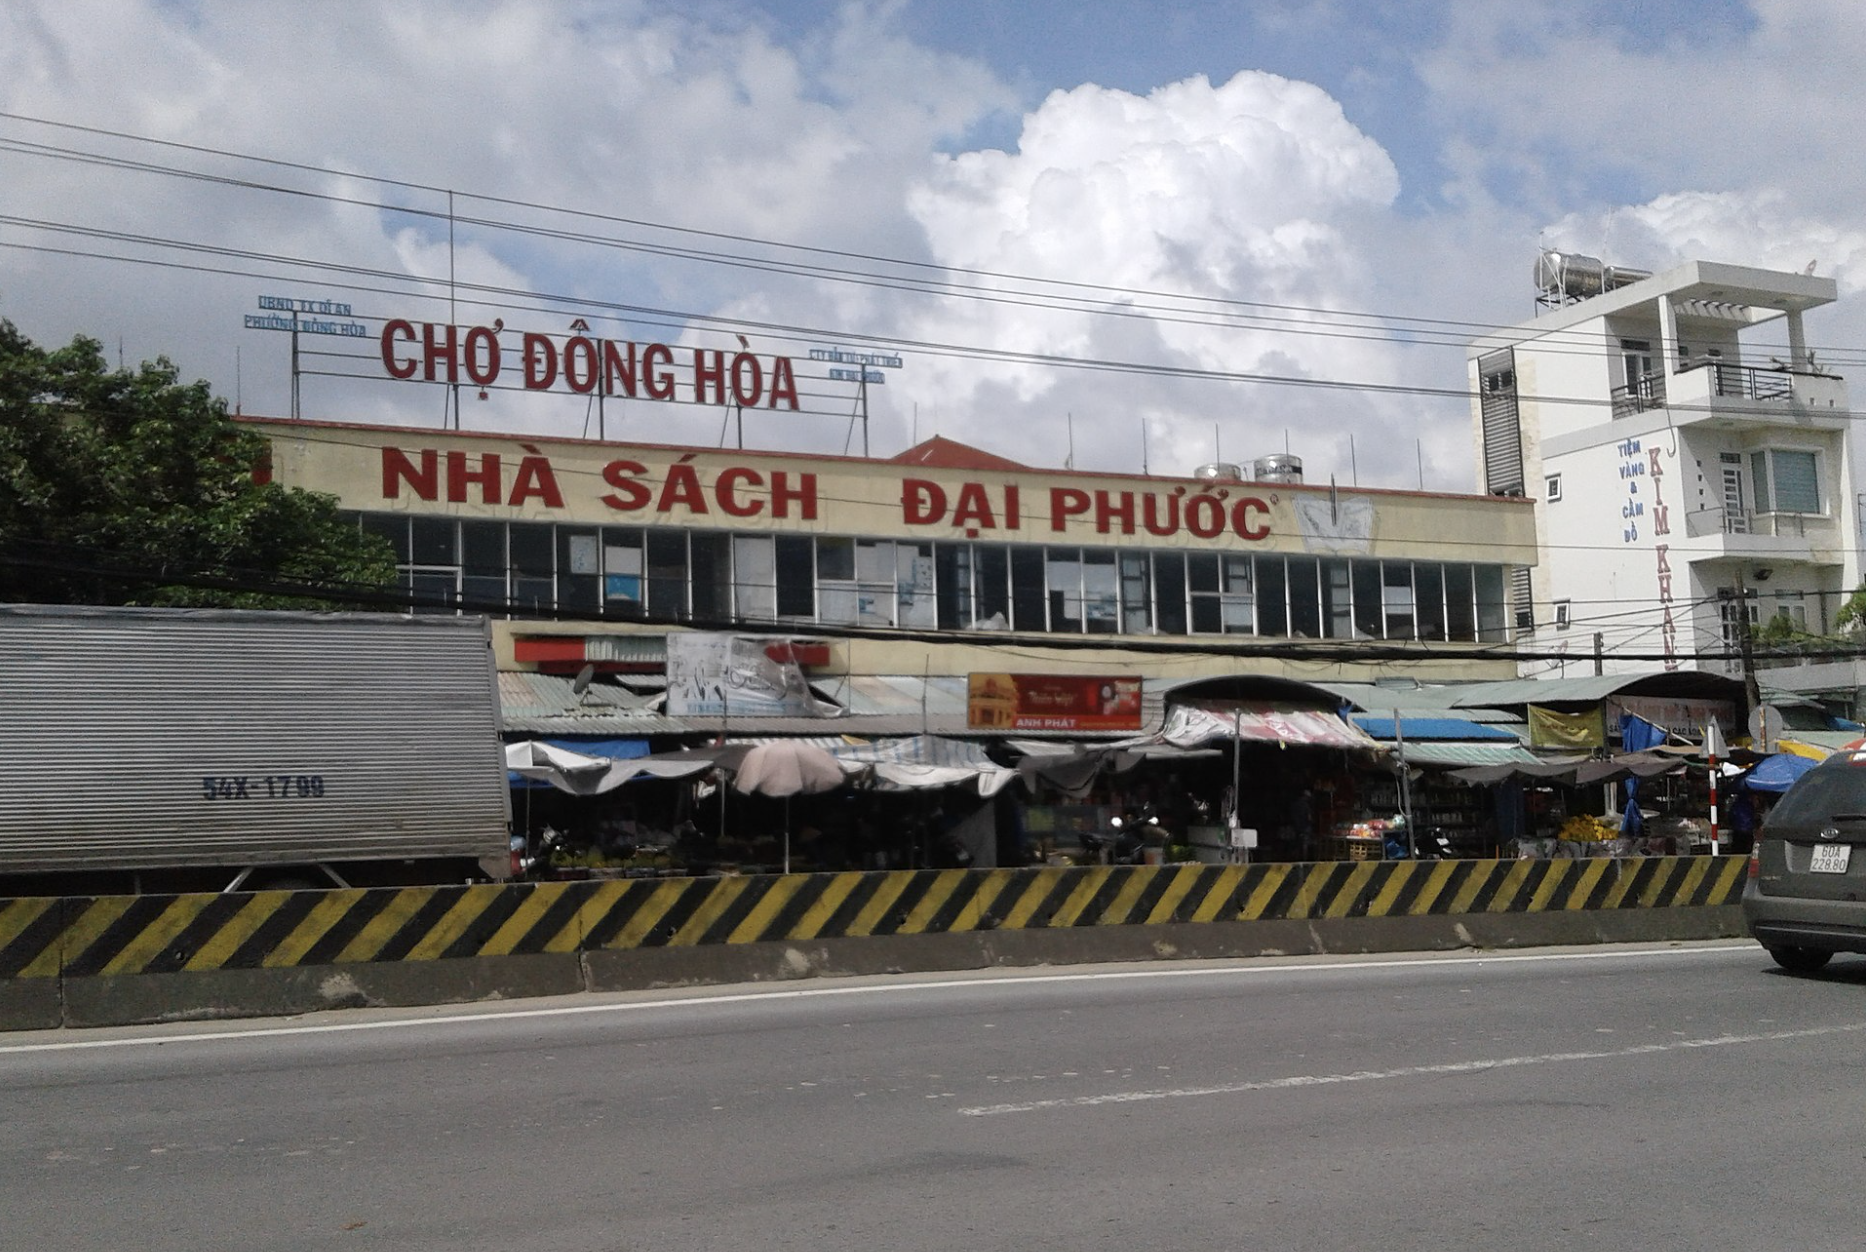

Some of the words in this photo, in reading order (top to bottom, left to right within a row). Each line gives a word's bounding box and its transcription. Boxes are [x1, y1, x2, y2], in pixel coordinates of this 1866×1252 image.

[381, 318, 504, 400] CHỢ
[522, 318, 676, 401] ĐÔNG
[694, 334, 799, 411] HÒA
[1617, 438, 1642, 459] TIỆM
[1619, 461, 1645, 480] VÀNG
[381, 443, 565, 509] NHÀ
[601, 453, 819, 521] SÁCH
[900, 478, 1021, 539] ĐẠI
[1050, 484, 1271, 542] PHƯỚC
[1648, 446, 1671, 536] KIM
[1016, 718, 1042, 728] ANH
[1044, 716, 1077, 728] PHÁT
[1822, 845, 1840, 859] 60A
[1811, 858, 1846, 871] 228.80
